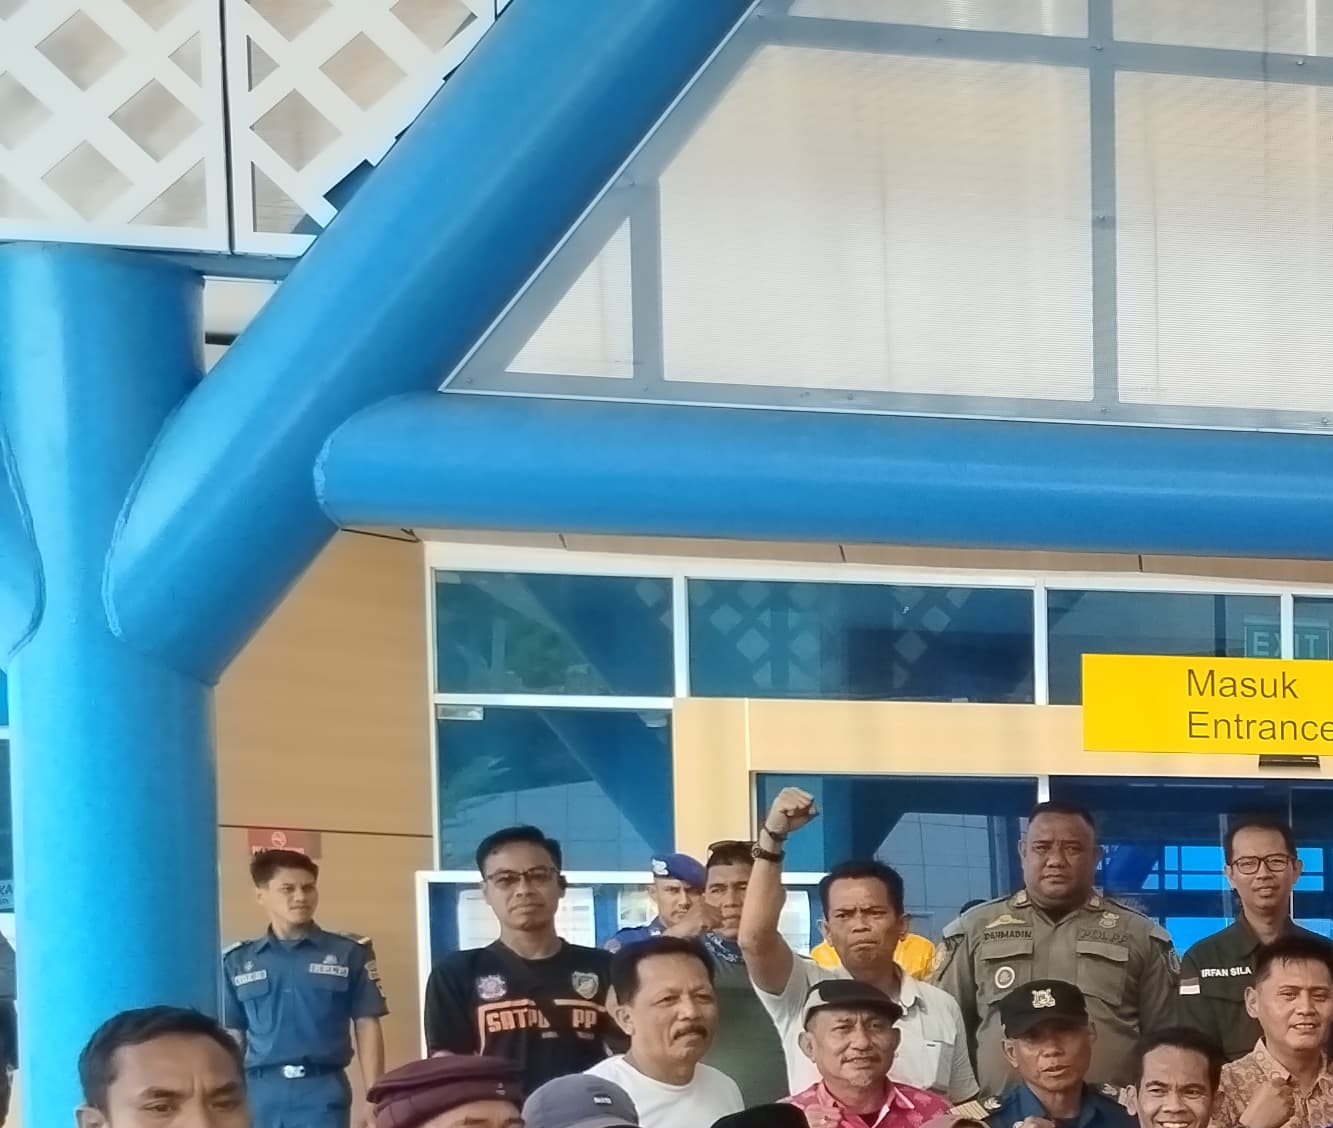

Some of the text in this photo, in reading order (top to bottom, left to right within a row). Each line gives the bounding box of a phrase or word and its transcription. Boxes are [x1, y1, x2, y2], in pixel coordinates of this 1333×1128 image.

[1187, 669, 1299, 699] Masuk
[1201, 966, 1252, 977] IRFAN SILA
[572, 1008, 597, 1028] PP
